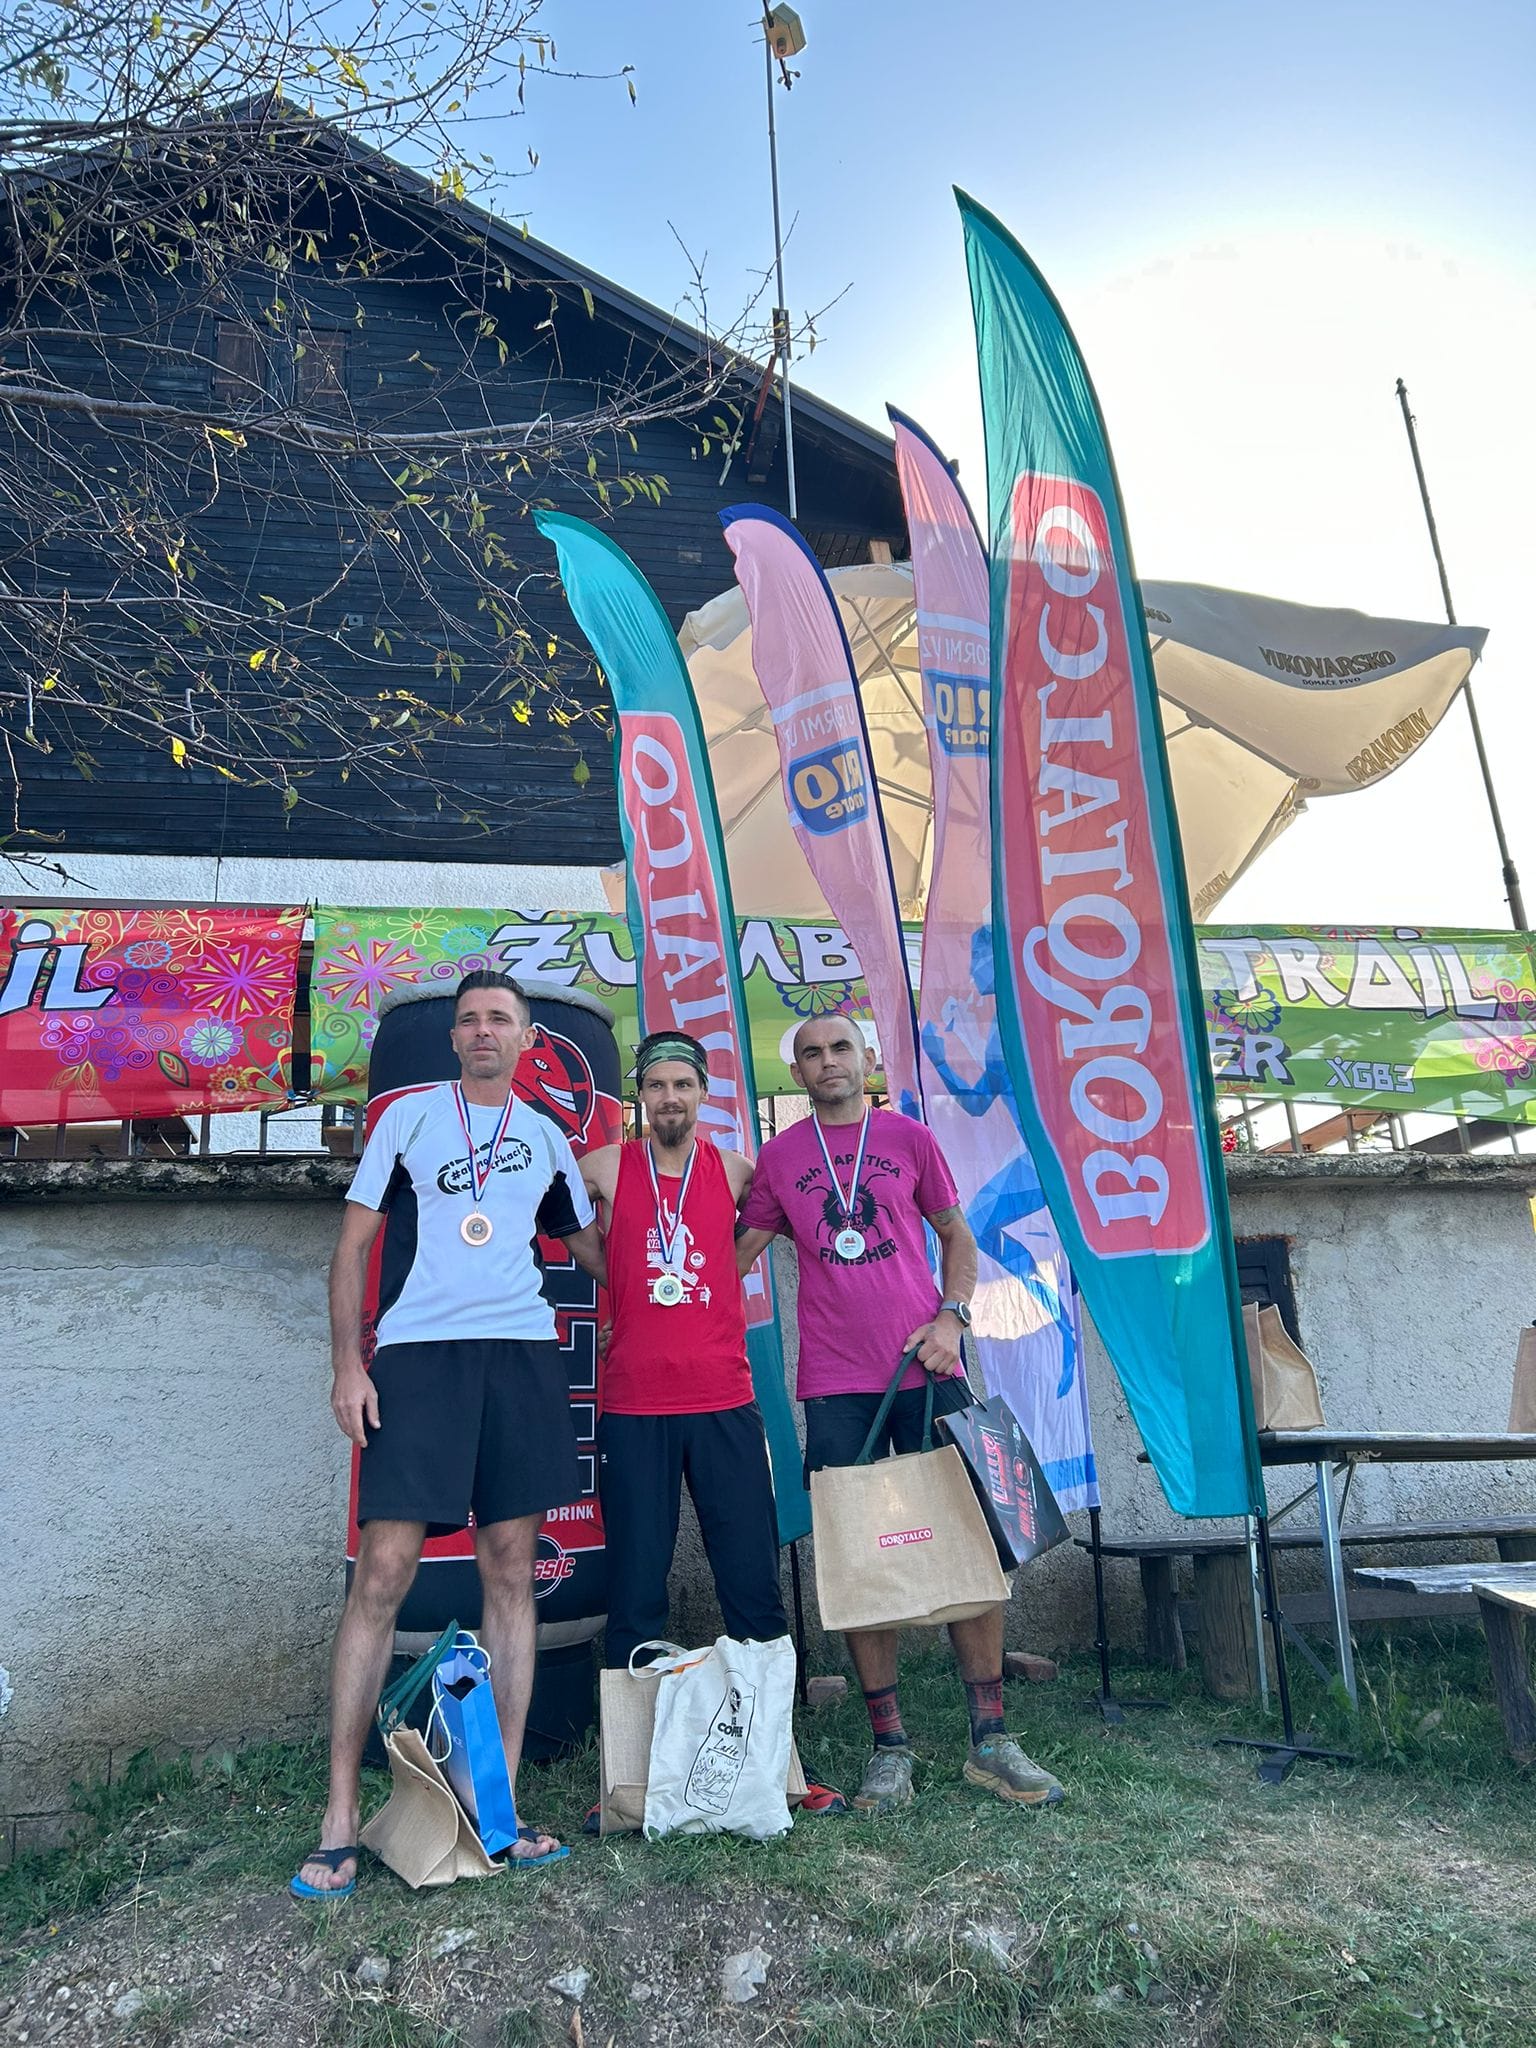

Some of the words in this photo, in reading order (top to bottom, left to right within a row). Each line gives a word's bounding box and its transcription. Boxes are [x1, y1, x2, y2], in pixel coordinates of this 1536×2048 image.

[1258, 645, 1396, 679] VUKOVARSKO
[795, 1166, 823, 1193] 24h
[823, 1153, 901, 1179] APTIČA
[546, 1504, 595, 1522] DRINK
[880, 1529, 932, 1546] BOROTALCO
